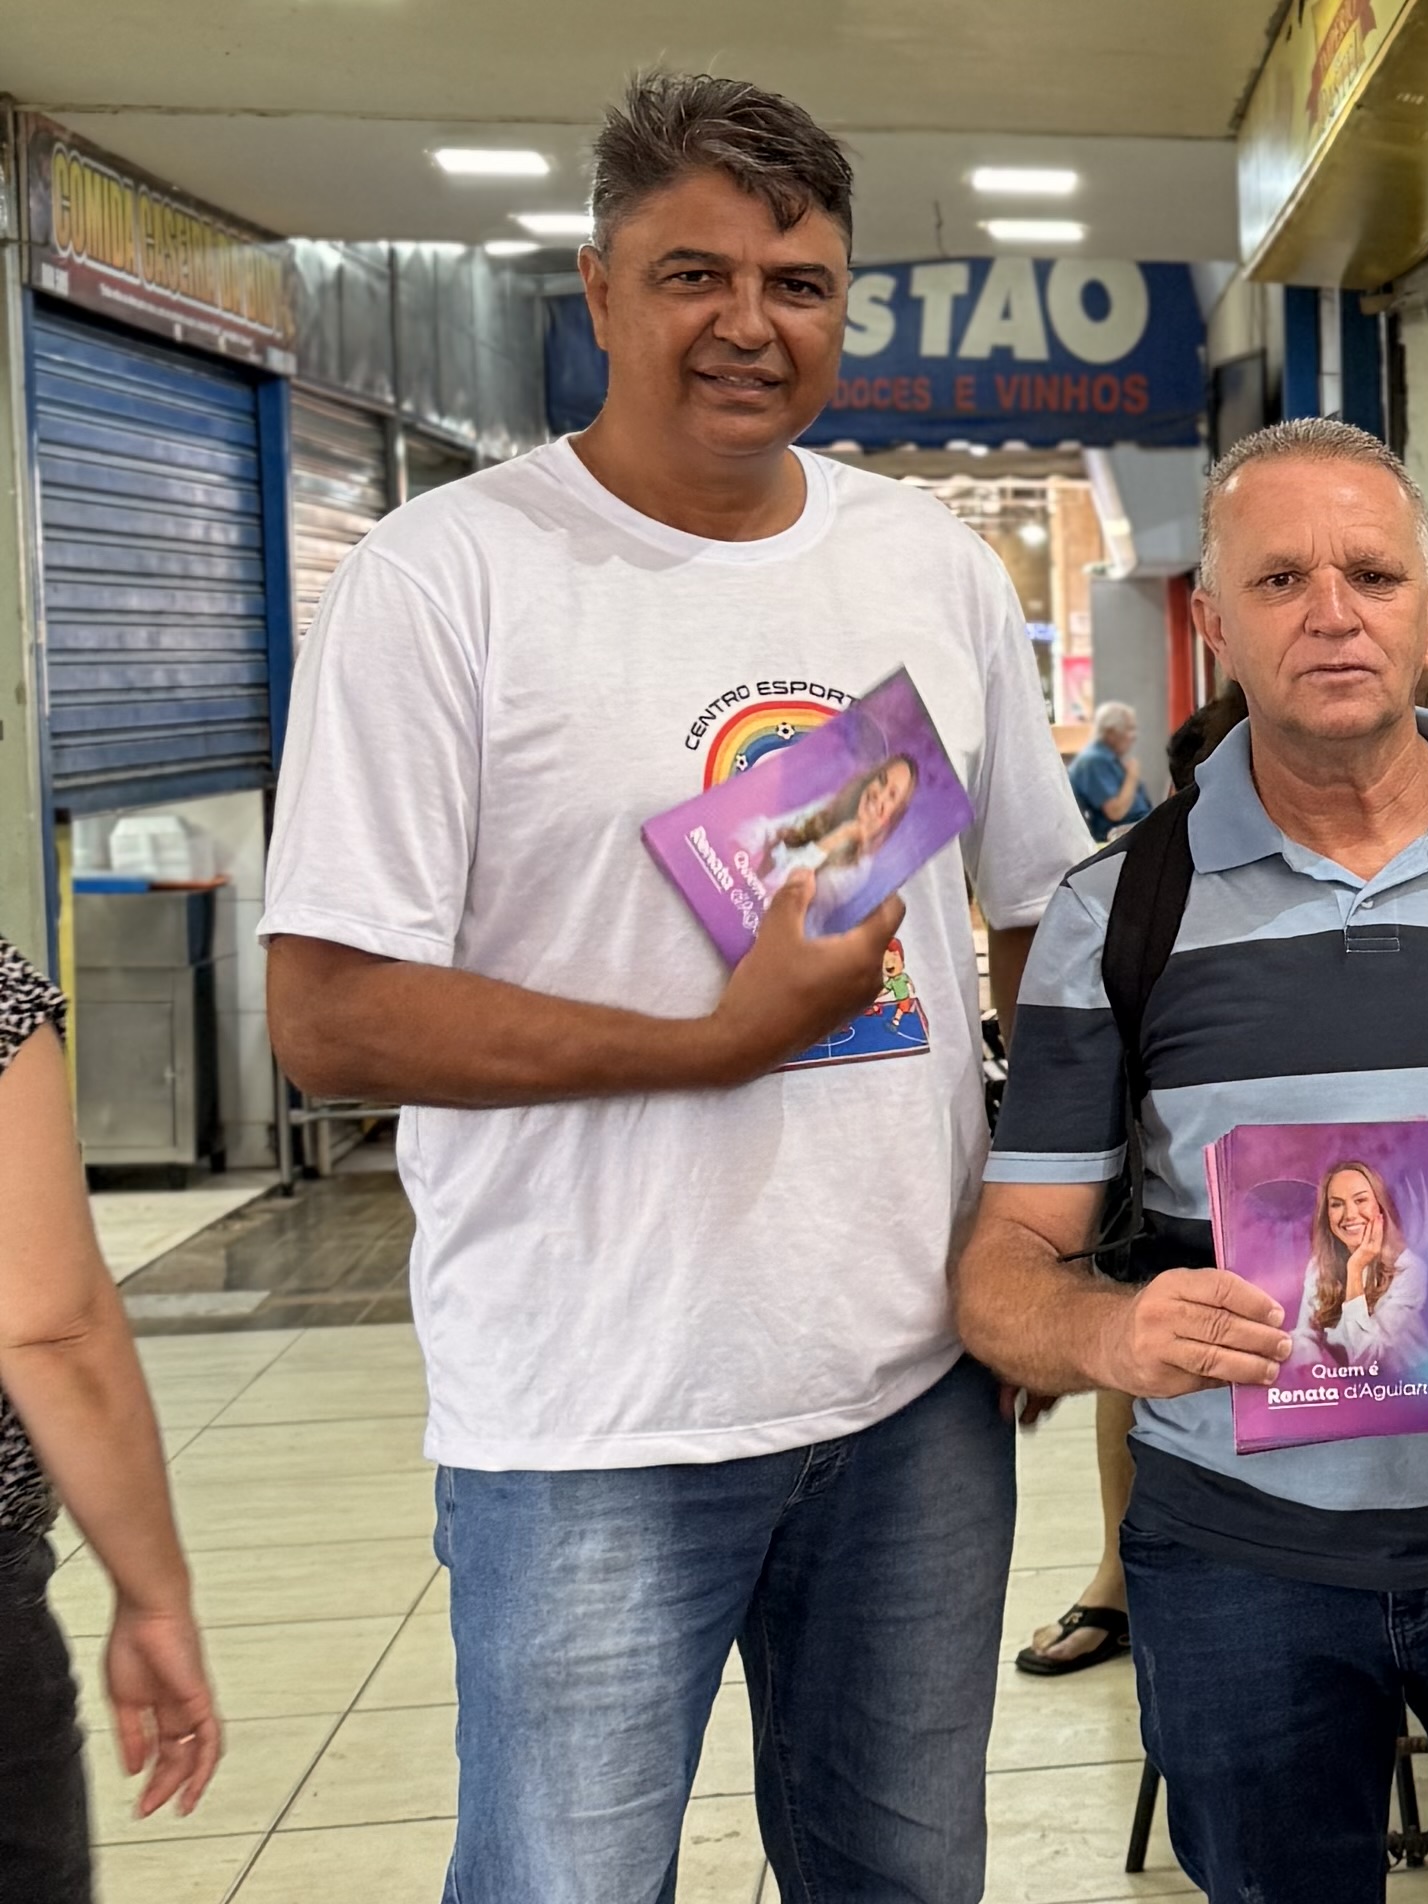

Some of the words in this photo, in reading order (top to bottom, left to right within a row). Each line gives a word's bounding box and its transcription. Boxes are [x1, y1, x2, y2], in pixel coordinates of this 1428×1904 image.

[53, 144, 138, 284] COMIDA
[832, 376, 931, 411] DOCES
[955, 375, 976, 411] E
[995, 373, 1150, 415] VINHOS
[684, 683, 752, 752] CENTRO
[756, 680, 861, 706] ESPORT
[1311, 1363, 1365, 1380] Quem
[1368, 1360, 1379, 1376] é
[1267, 1386, 1339, 1404] Renata
